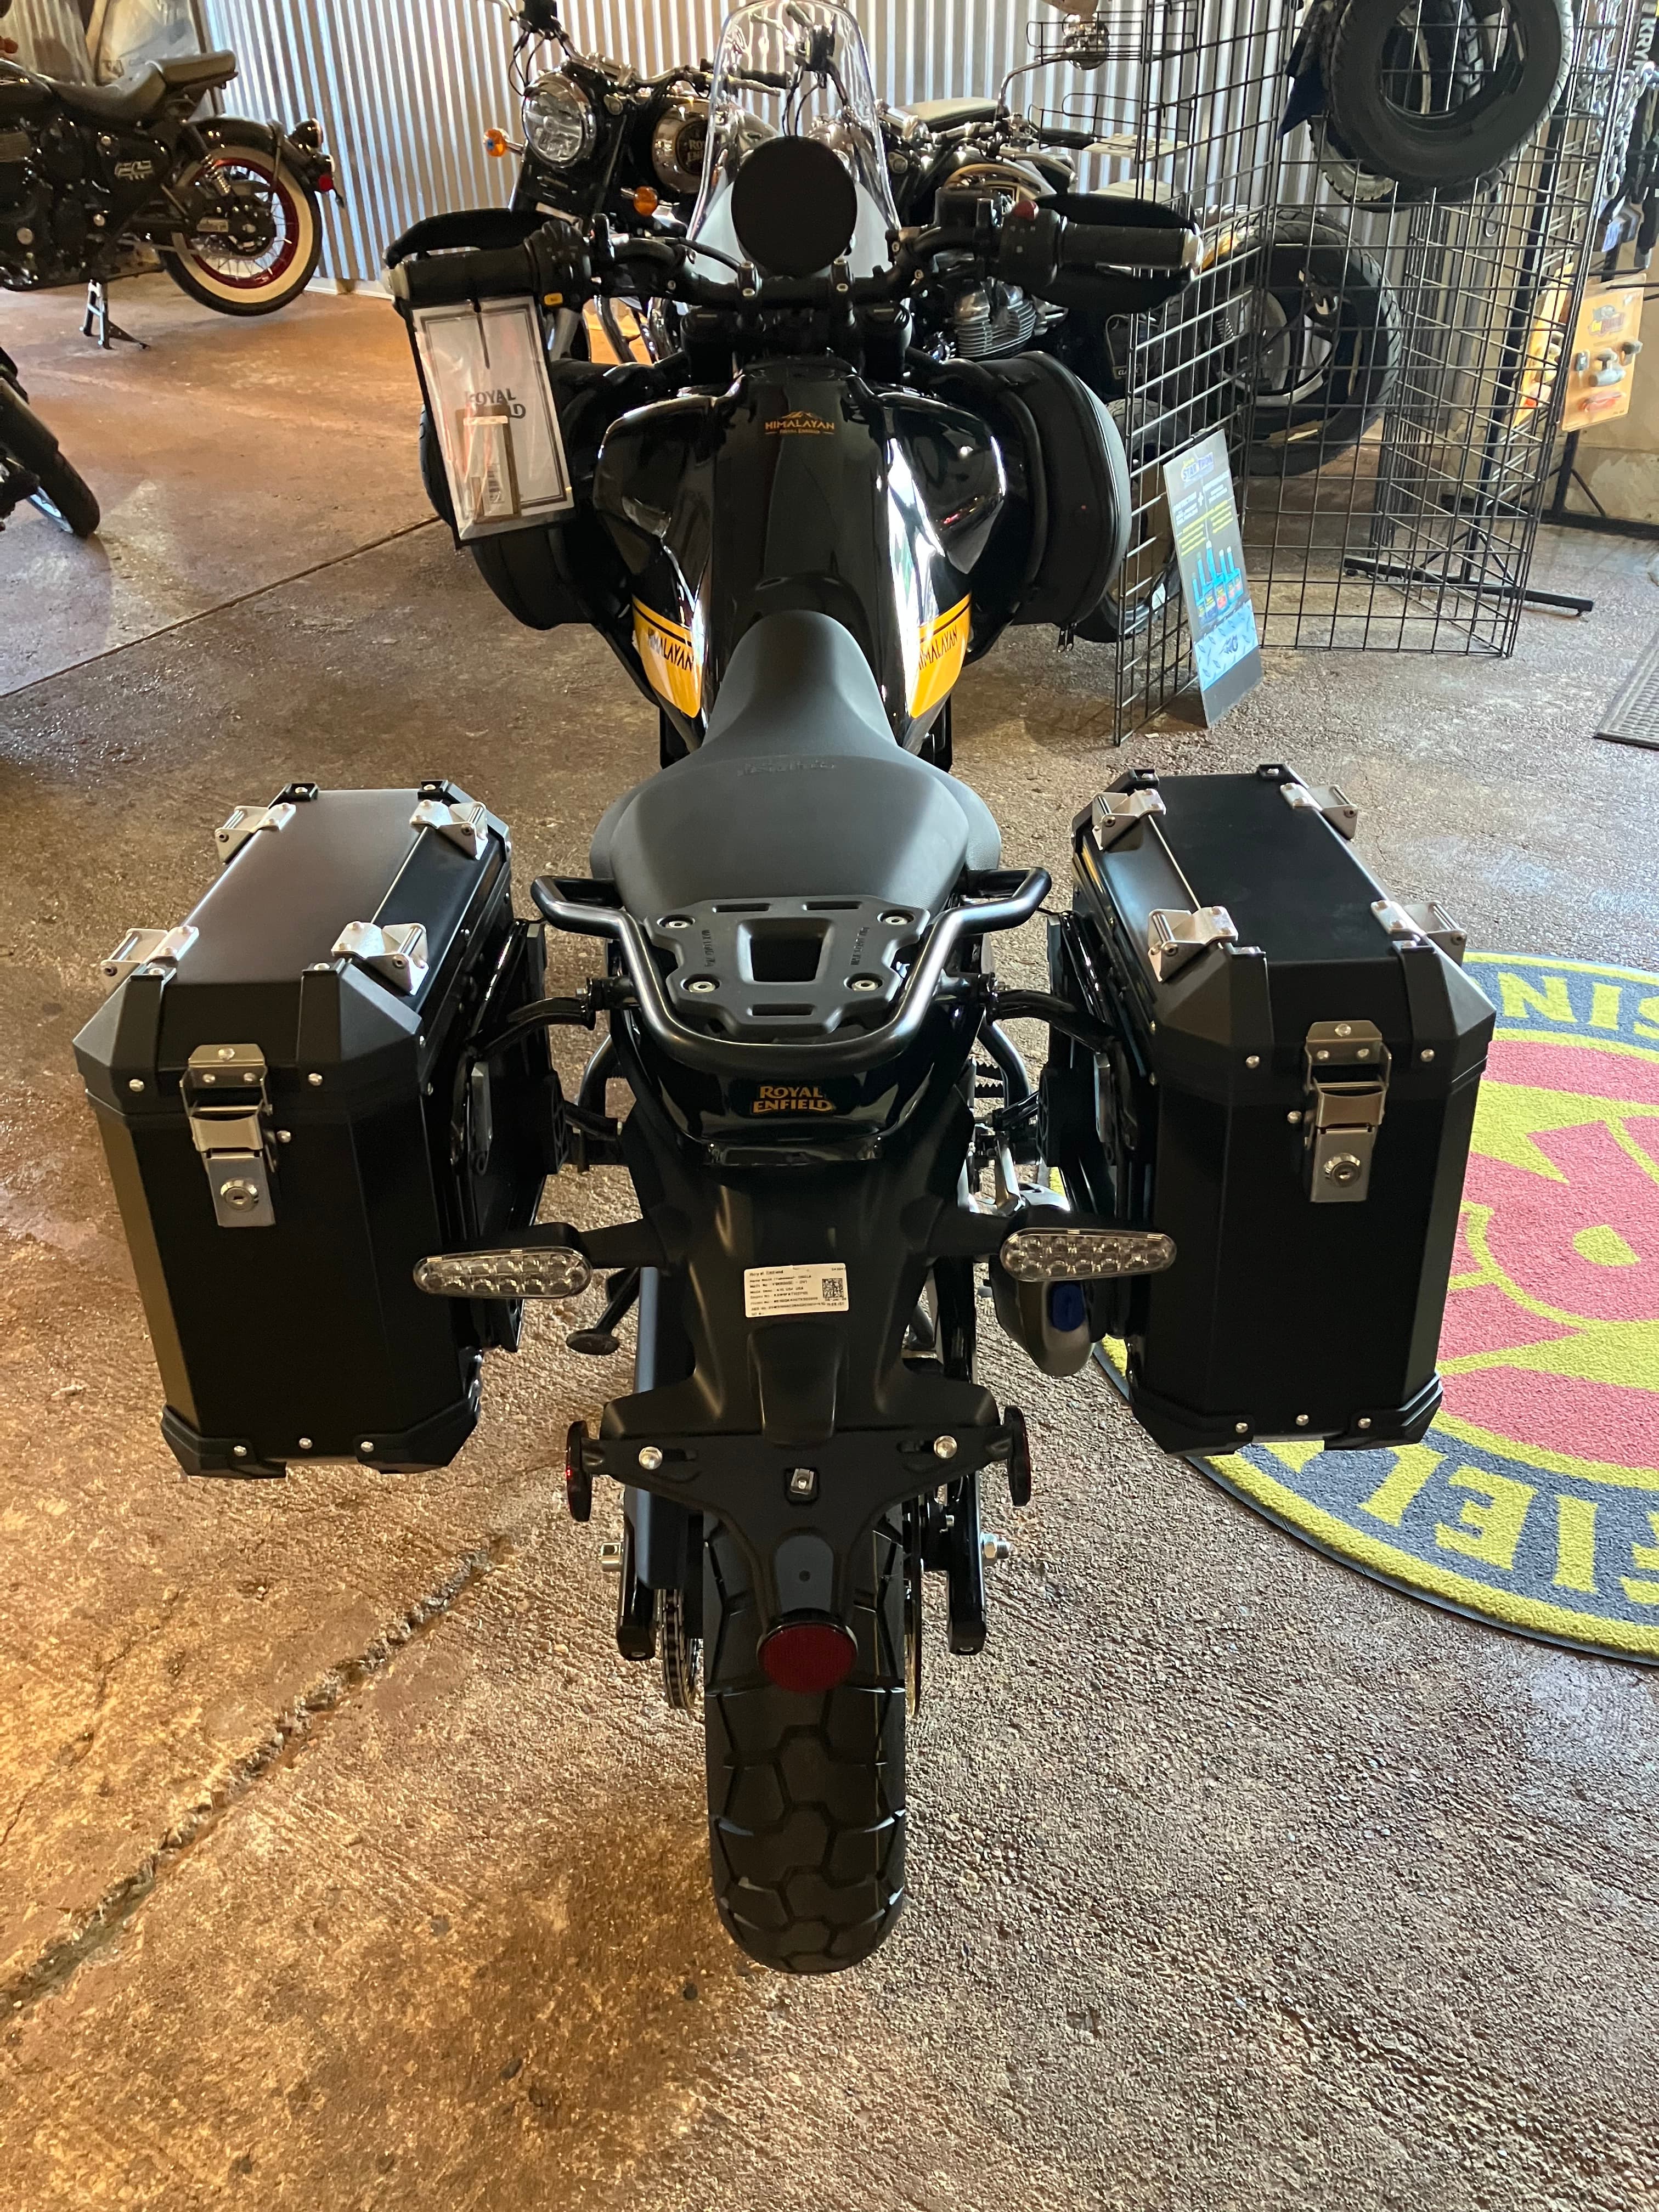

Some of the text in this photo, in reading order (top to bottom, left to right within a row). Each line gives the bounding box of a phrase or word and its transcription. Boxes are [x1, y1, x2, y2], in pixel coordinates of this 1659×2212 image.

[1633, 18, 1657, 72] KRYP
[765, 420, 834, 430] HIMALAYAN
[648, 627, 695, 673] MALAYAN
[918, 624, 958, 671] IMALAYAN
[753, 1099, 834, 1113] ENFIELD
[760, 1086, 823, 1099] ROYAL
